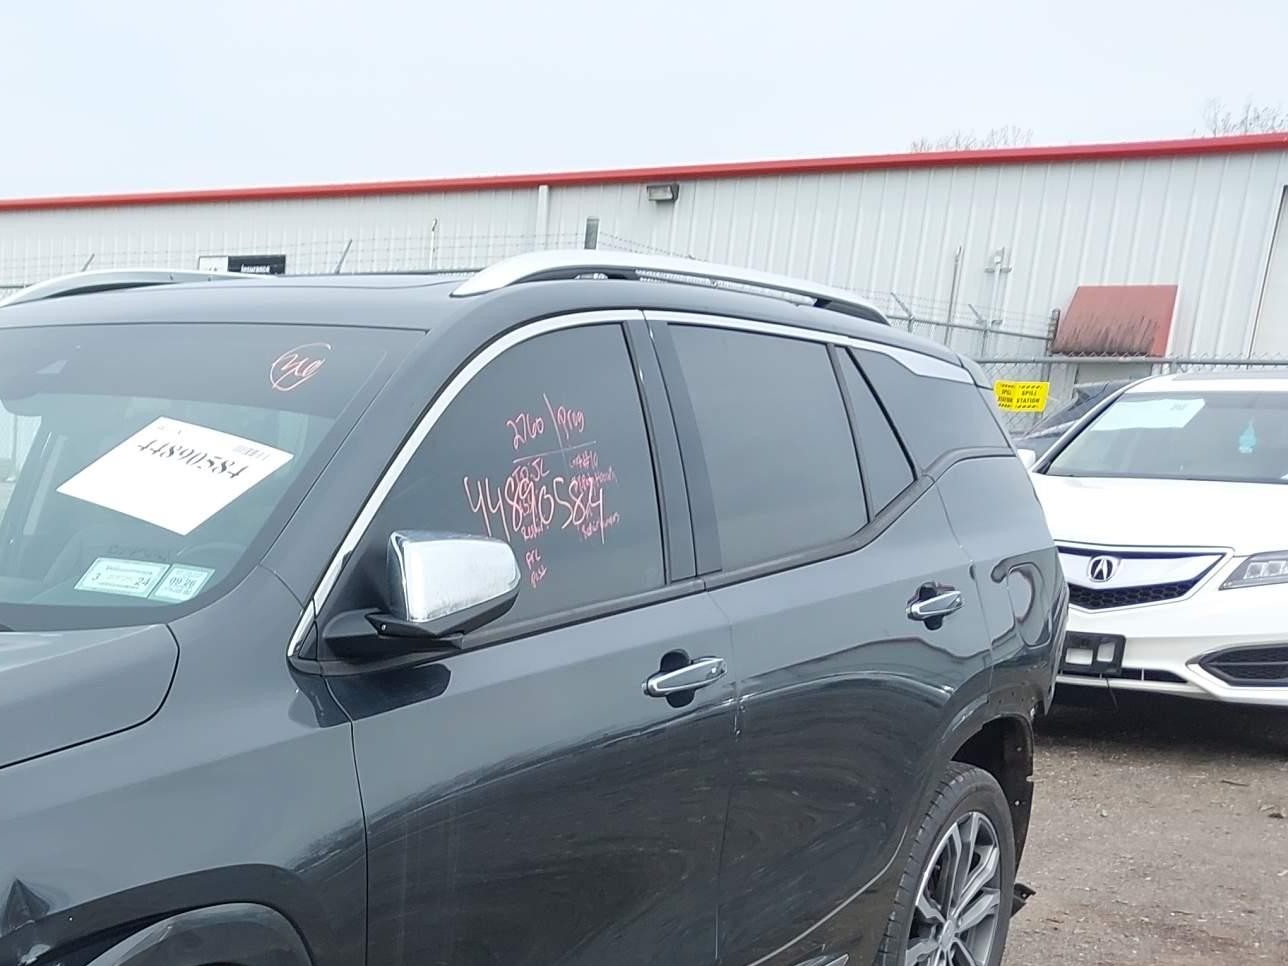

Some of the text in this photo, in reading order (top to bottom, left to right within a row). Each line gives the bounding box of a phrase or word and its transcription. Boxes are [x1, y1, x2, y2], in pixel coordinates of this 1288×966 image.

[240, 263, 270, 273] Insurance
[506, 412, 545, 450] 2760
[137, 439, 249, 479] 44890584
[464, 476, 605, 545] 44890584
